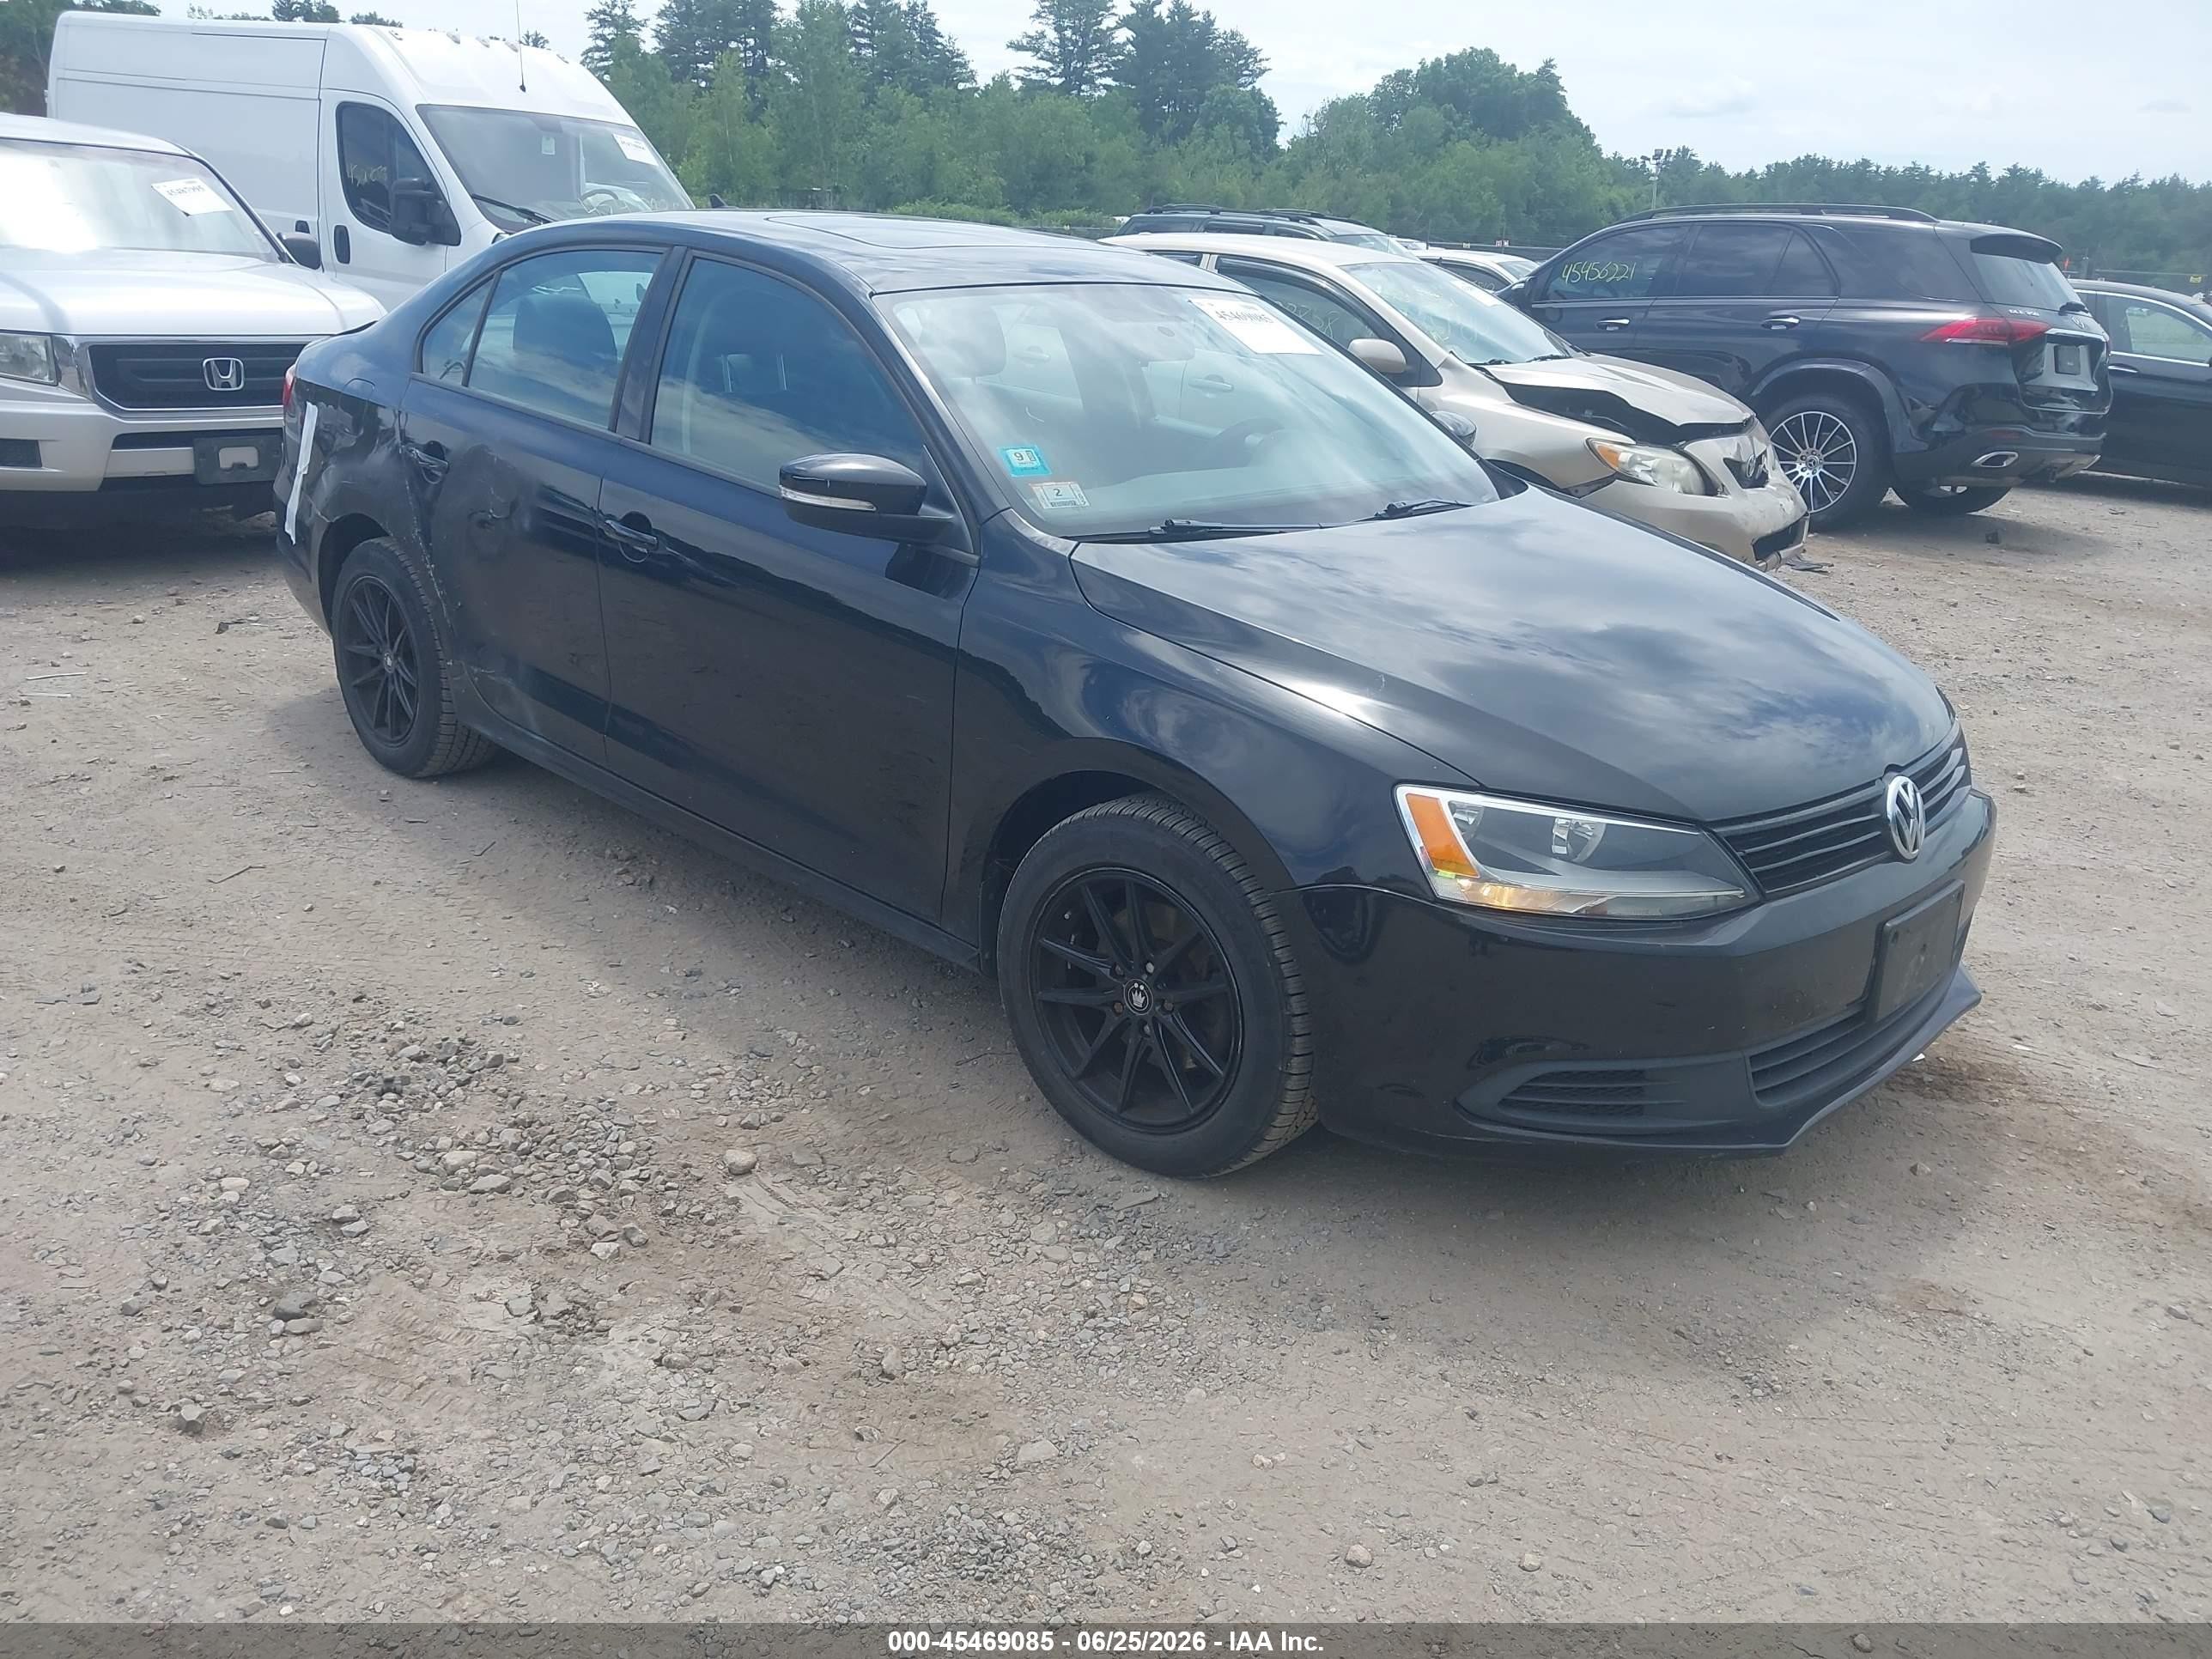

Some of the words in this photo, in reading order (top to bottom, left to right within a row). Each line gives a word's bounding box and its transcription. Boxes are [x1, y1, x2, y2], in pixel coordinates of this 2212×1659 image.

[1562, 261, 1637, 285] 45456221
[1014, 452, 1024, 461] 9
[1053, 488, 1063, 497] 2
